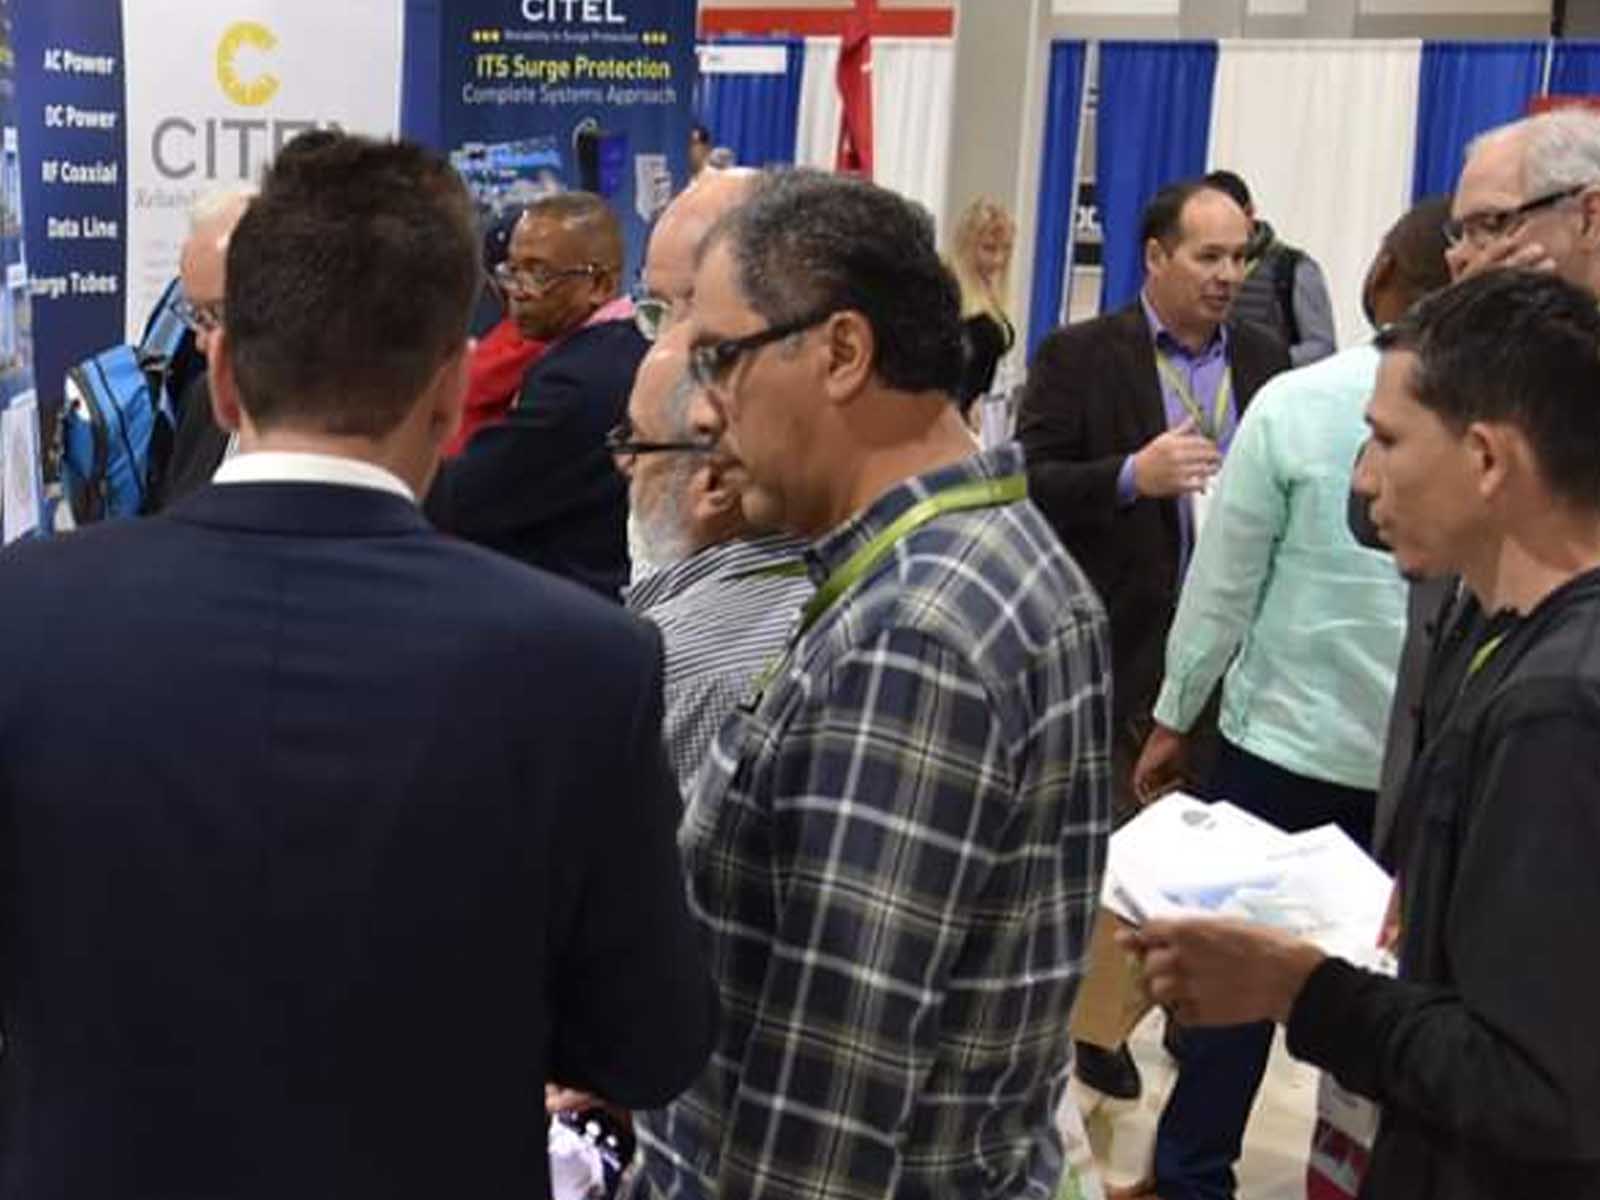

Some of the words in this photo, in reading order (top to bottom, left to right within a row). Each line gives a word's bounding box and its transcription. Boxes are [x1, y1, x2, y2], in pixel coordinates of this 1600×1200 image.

[521, 0, 626, 23] CITEL
[44, 49, 61, 70] AC
[63, 50, 114, 75] Power
[476, 54, 509, 78] ITS
[513, 54, 570, 84] Surge
[574, 56, 671, 79] Protection
[462, 82, 535, 104] Complete
[540, 83, 600, 105] Systems
[607, 84, 677, 105] Approach
[66, 104, 116, 128] Power
[151, 117, 318, 179] CIT
[61, 161, 117, 184] Coaxial
[47, 216, 79, 238] Data
[83, 216, 117, 239] Line
[70, 270, 118, 294] Tubes
